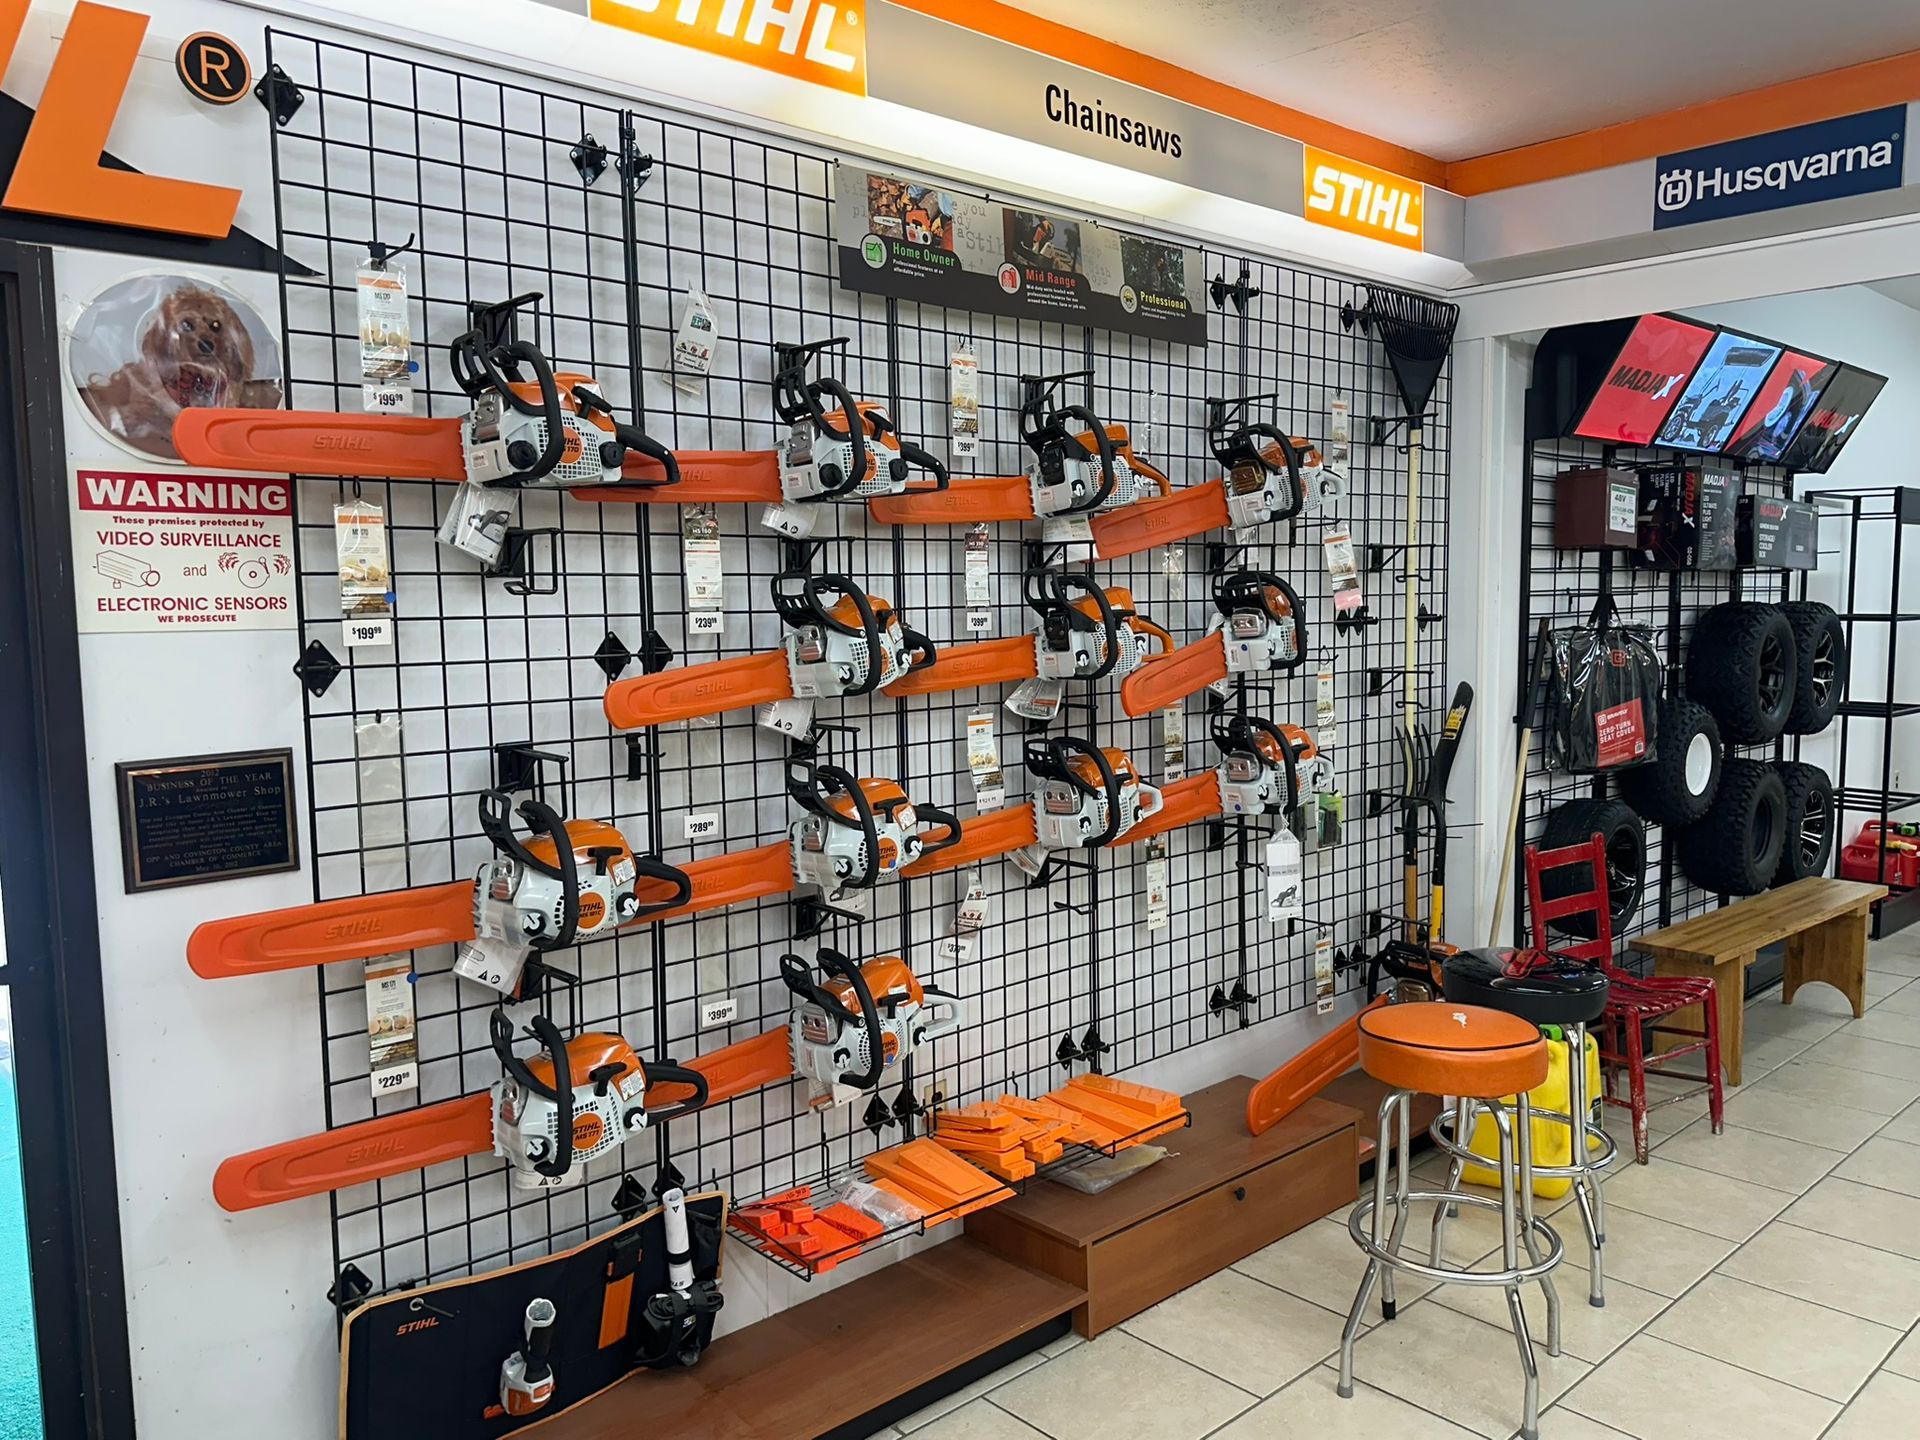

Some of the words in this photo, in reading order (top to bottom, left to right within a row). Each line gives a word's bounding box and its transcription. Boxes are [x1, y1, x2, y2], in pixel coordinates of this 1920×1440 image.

[1045, 84, 1182, 159] Chainsaws
[1696, 141, 1892, 201] Husqvarna
[1308, 165, 1419, 237] STIHL
[893, 242, 920, 259] Home
[923, 249, 955, 267] Owner
[1026, 269, 1045, 283] Mid
[1048, 272, 1076, 288] Range
[1140, 291, 1187, 310] Professional
[1608, 364, 1685, 400] MADJAX
[314, 434, 371, 451] STIHL
[85, 477, 288, 511] WARNING
[1682, 471, 1696, 528] MADJAX
[112, 516, 145, 525] These
[148, 517, 197, 527] premises
[200, 518, 249, 527] protected
[252, 520, 265, 528] by
[96, 531, 154, 546] VIDEO
[160, 532, 281, 548] SURVEILLANCE
[183, 564, 207, 577] and
[97, 597, 209, 612] ELECTRONIC
[214, 596, 288, 611] SENSORS
[158, 615, 174, 623] WE
[177, 614, 237, 623] PROSECUTE
[695, 681, 732, 697] STIHL
[1600, 720, 1631, 737] ZERO-TURN
[1600, 733, 1615, 744] SEAT
[1616, 726, 1635, 738] COVER
[146, 779, 195, 792] BUSINESS
[199, 777, 213, 786] OF
[220, 775, 239, 784] THE
[245, 772, 272, 782] YEAR
[200, 768, 220, 778] 2012
[178, 789, 247, 804] Lawnmower
[254, 785, 281, 797] Shop
[324, 918, 382, 940] STIHL
[572, 1122, 600, 1134] STIHL
[348, 1136, 406, 1164] STIHL
[396, 1316, 439, 1336] STIHL
